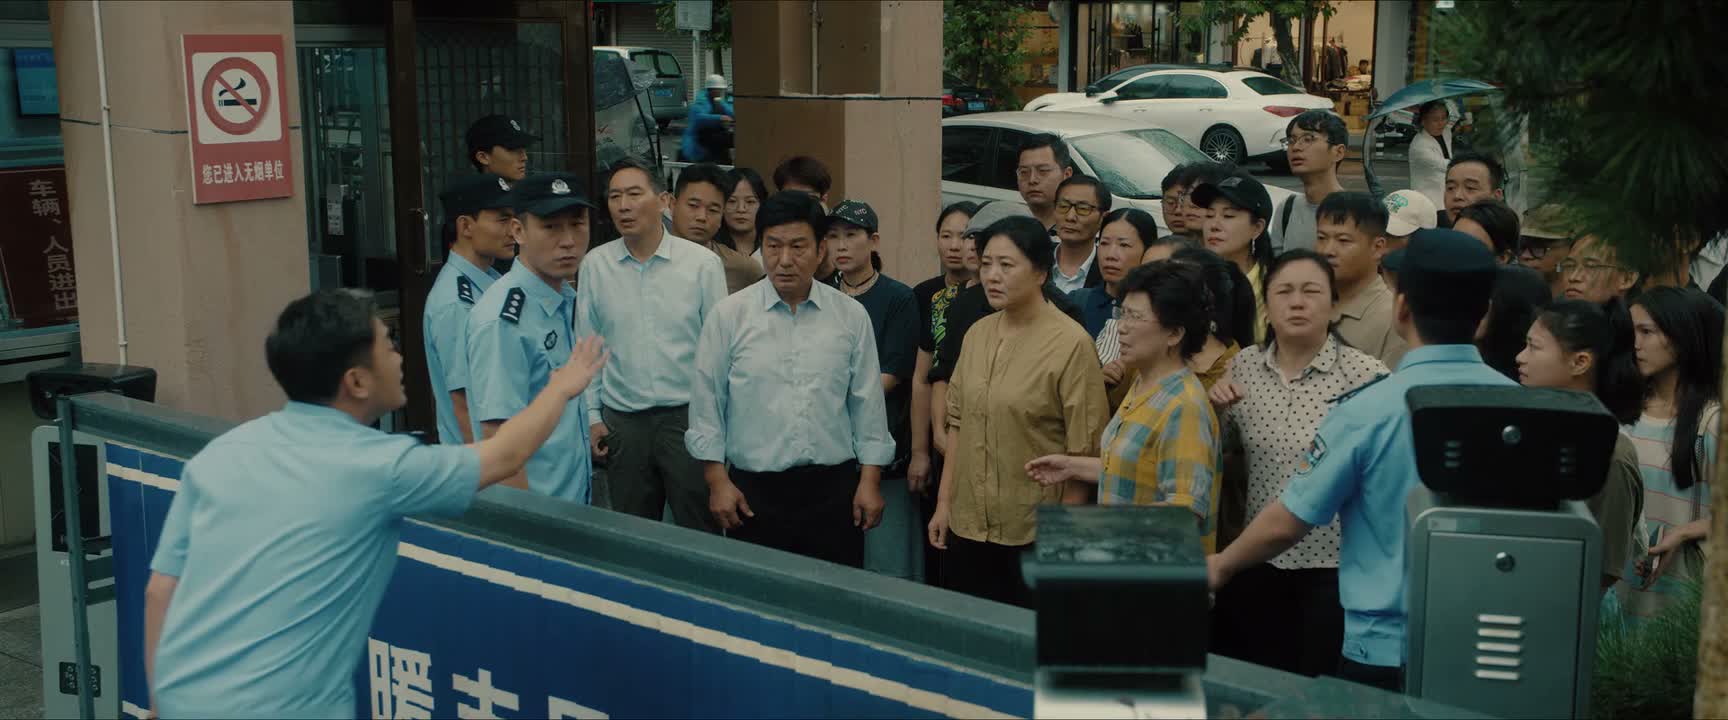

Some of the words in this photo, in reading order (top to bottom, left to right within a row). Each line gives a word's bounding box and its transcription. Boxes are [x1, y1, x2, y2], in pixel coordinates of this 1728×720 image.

[202, 160, 285, 184] 您已进入无烟单位
